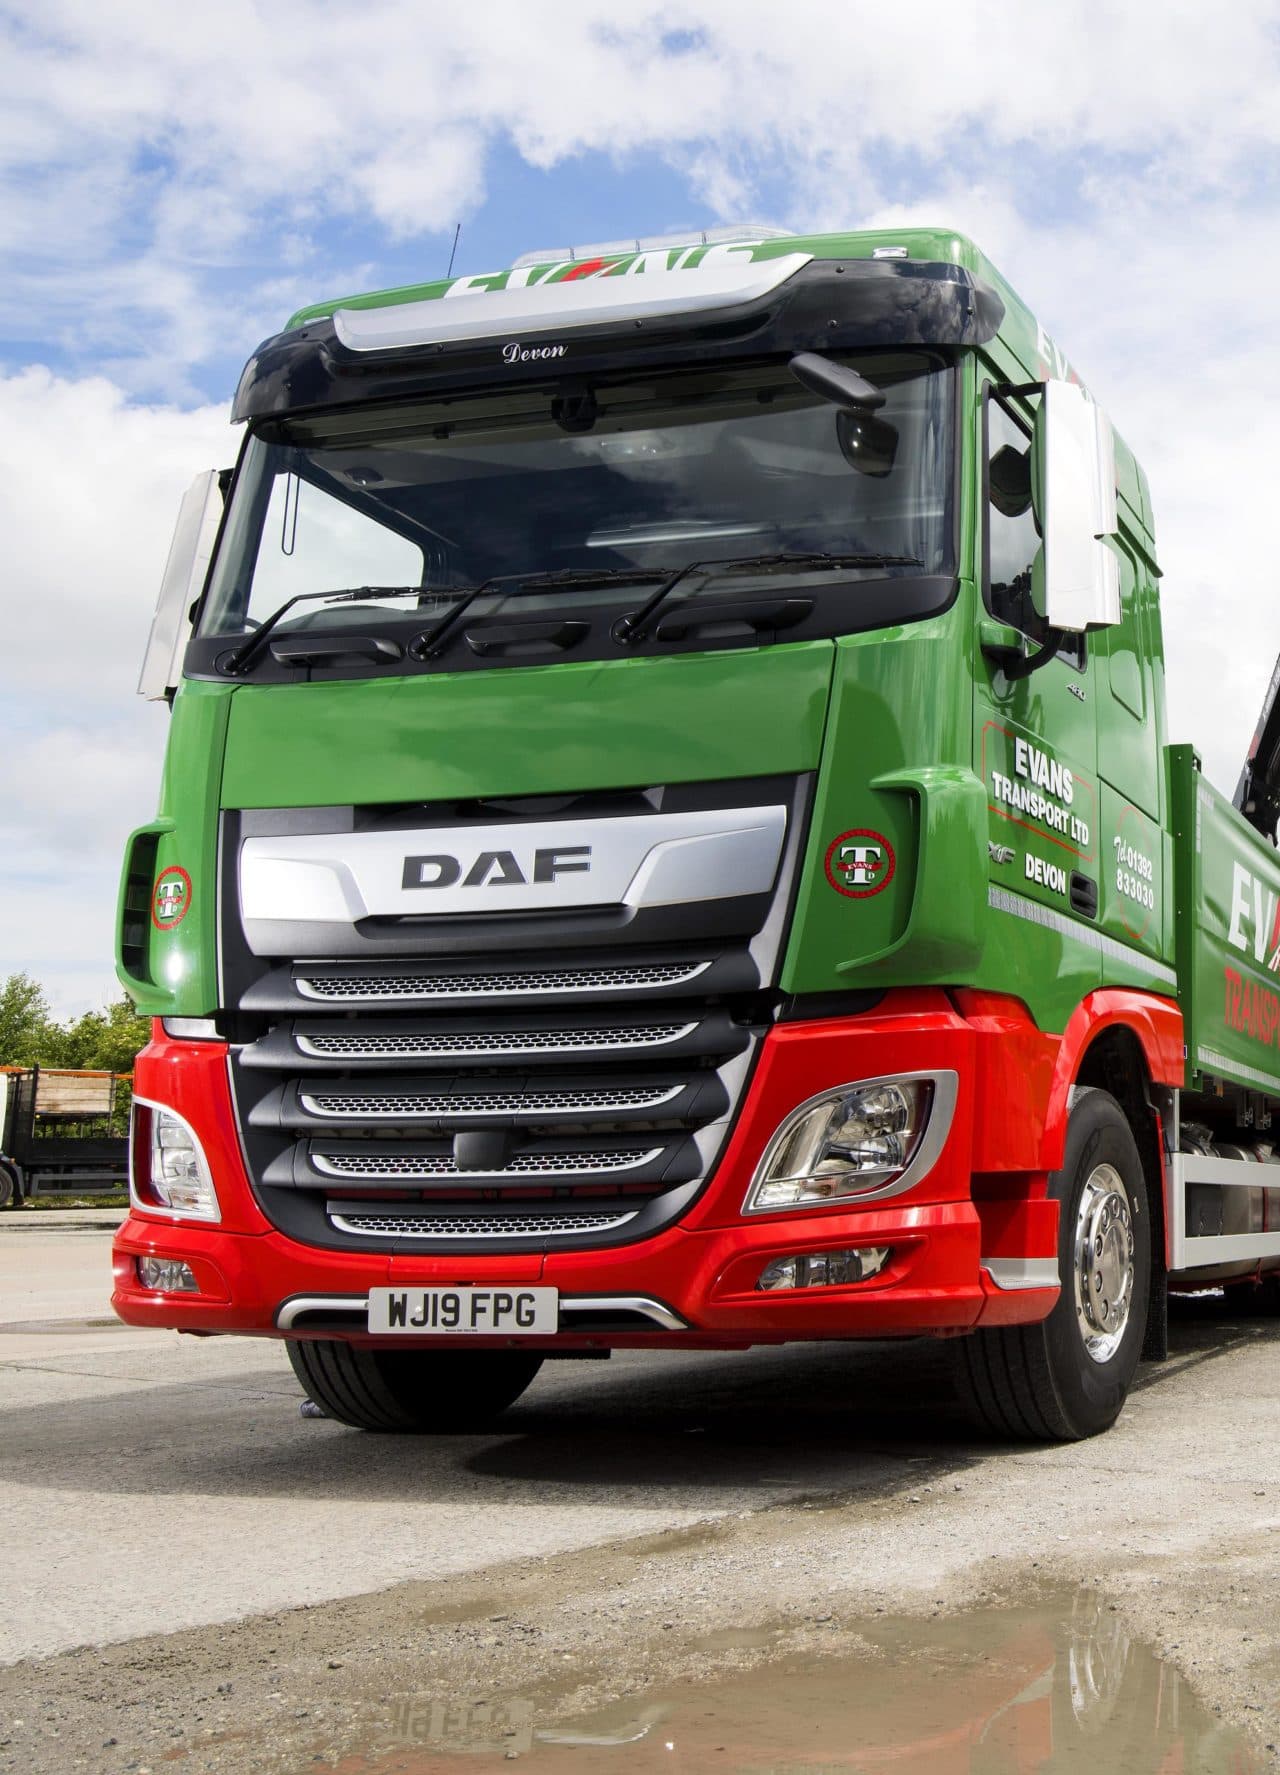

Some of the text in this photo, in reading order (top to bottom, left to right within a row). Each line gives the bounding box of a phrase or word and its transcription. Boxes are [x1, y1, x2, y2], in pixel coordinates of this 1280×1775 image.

[502, 342, 568, 364] Devon
[1015, 736, 1073, 805] EVANS
[992, 771, 1089, 846] TRANSPORT LTD
[402, 846, 592, 890] DAF
[988, 840, 1016, 864] XF
[1127, 846, 1152, 882] 01392
[1025, 853, 1066, 895] DEVON
[1116, 868, 1154, 910] 833030
[388, 1293, 536, 1328] WJ19 FPG
